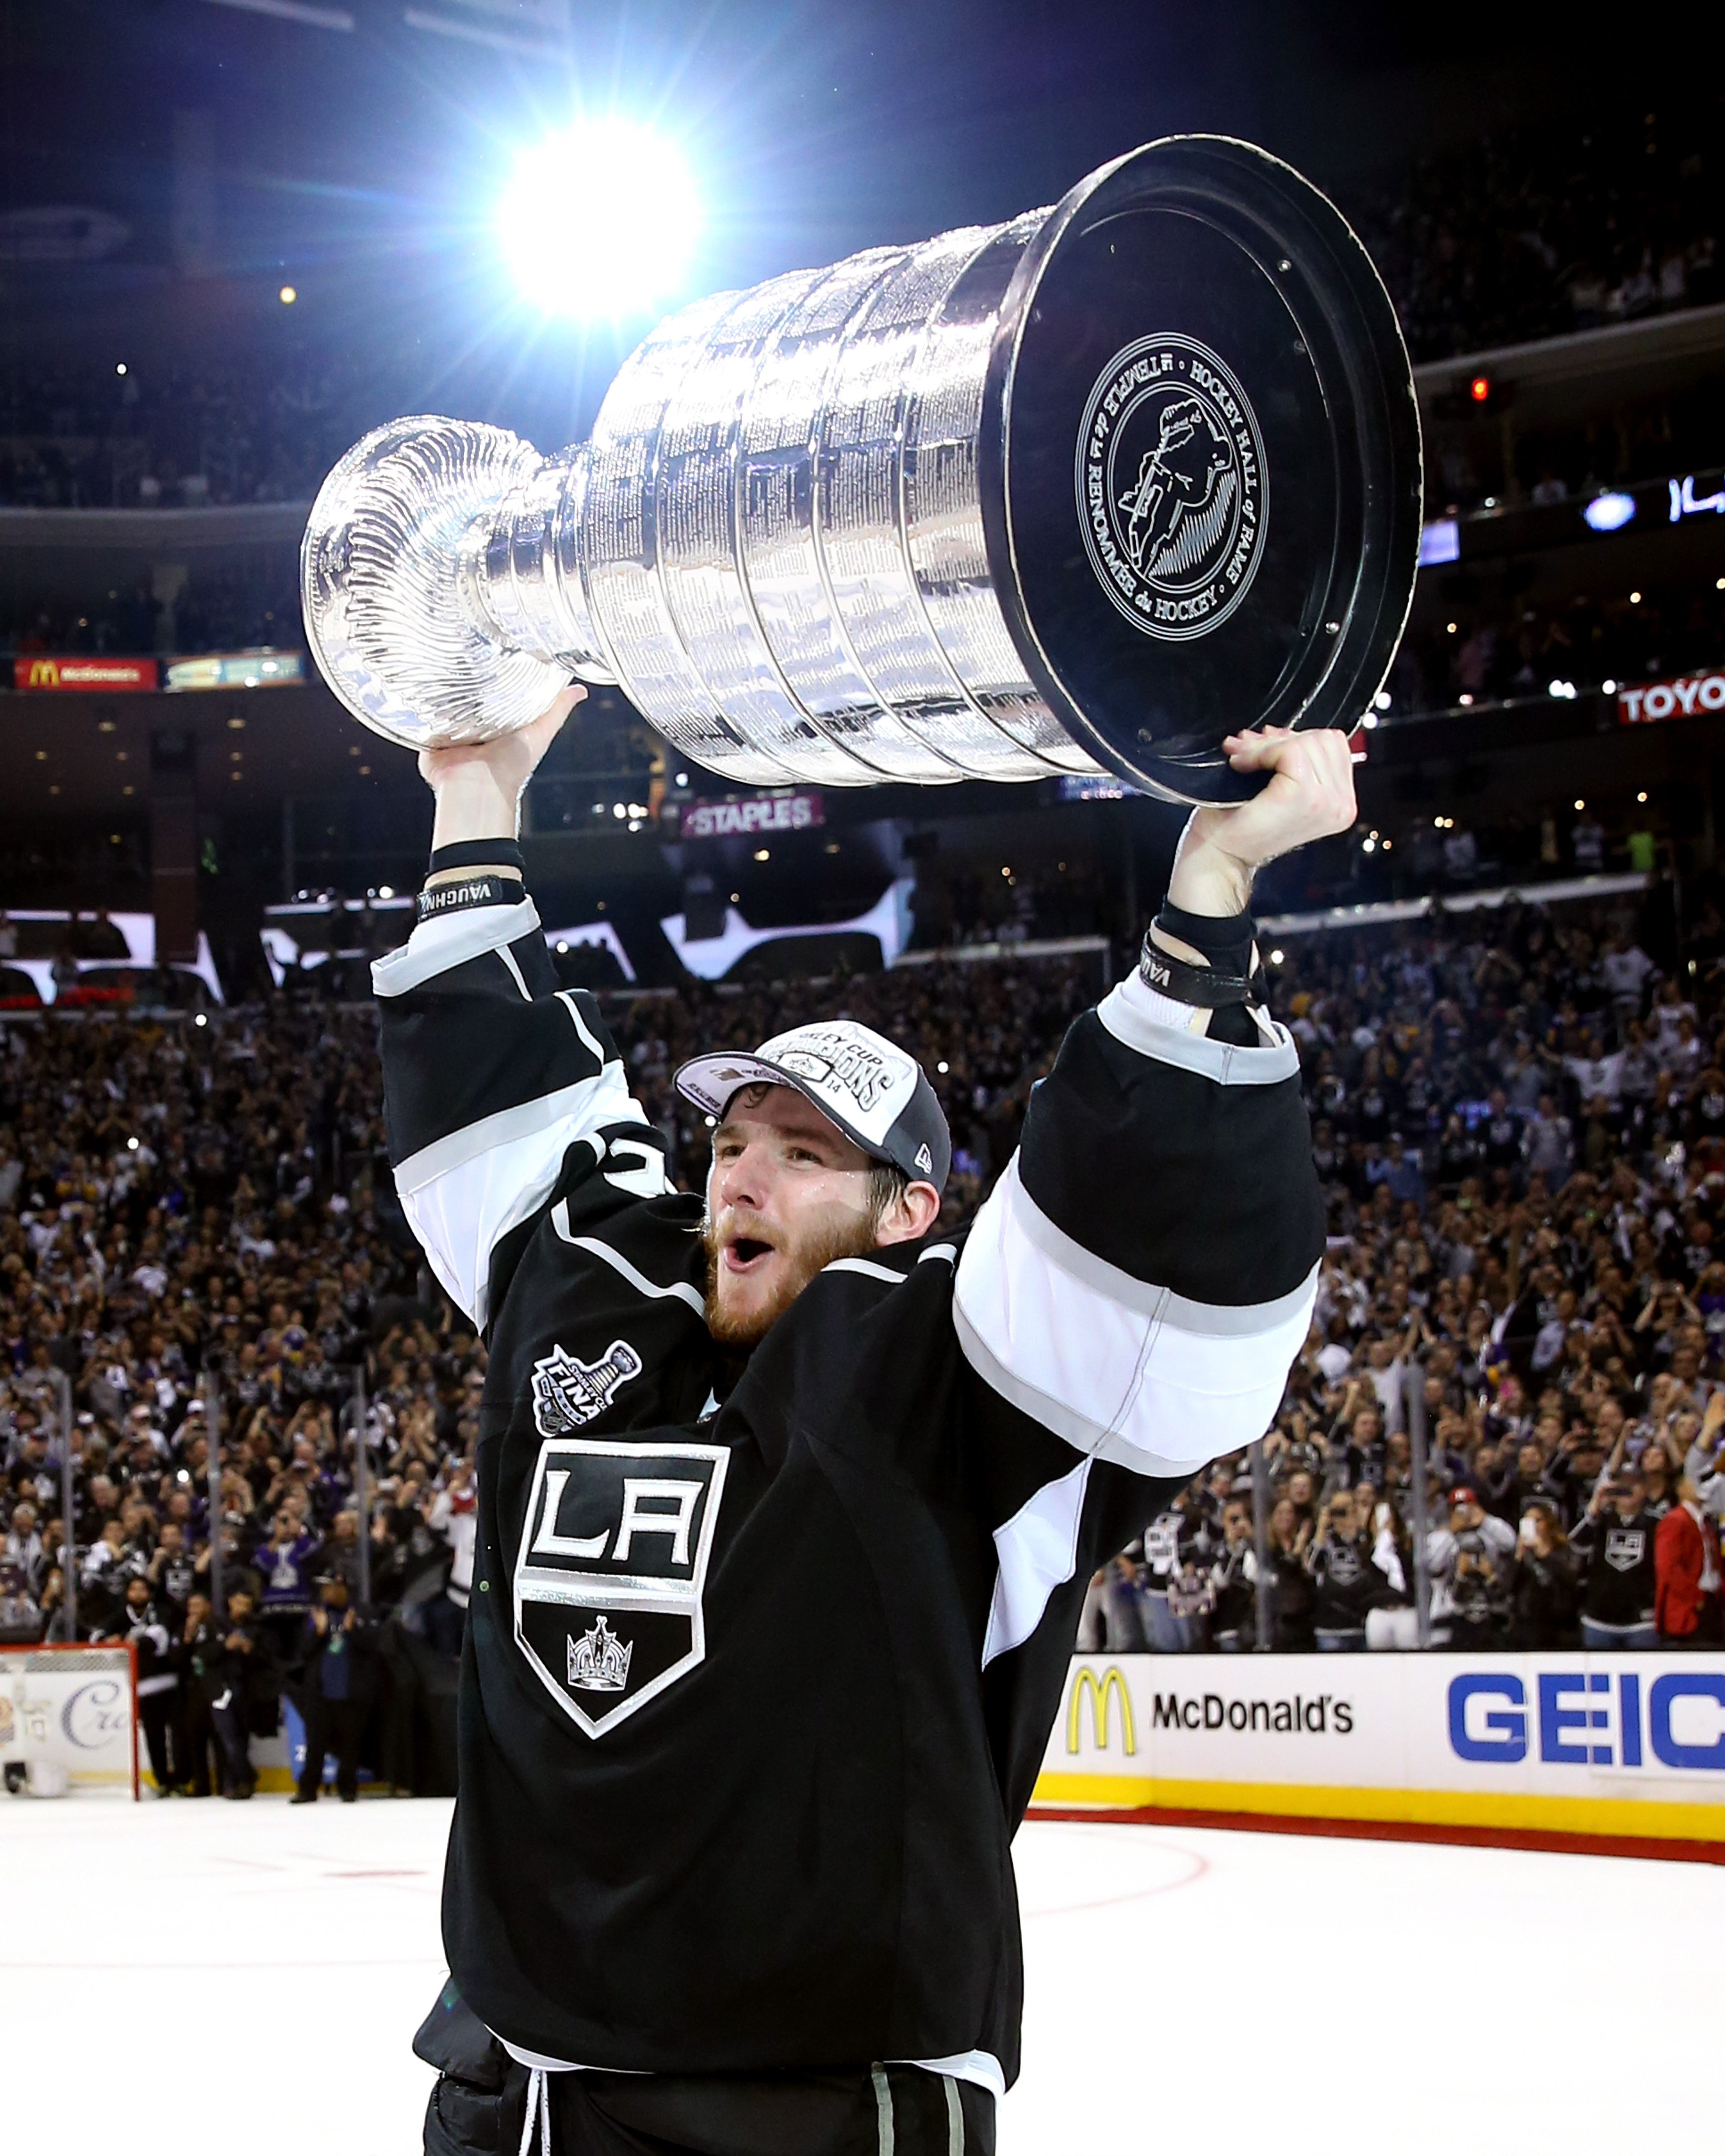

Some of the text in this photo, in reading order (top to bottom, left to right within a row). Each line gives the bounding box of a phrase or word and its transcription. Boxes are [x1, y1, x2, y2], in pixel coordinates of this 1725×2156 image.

[1103, 356, 1161, 416] TEMPLE
[1095, 412, 1109, 438] de
[1190, 360, 1257, 585] HOCKEY HALL of FAME
[1088, 463, 1137, 598] RENOMMÉE
[1135, 590, 1153, 613] du
[1154, 585, 1217, 621] HOCKEY
[1619, 676, 1725, 722] TOYO
[693, 796, 812, 835] STAPLES
[425, 884, 492, 912] VAUGHN
[846, 1044, 883, 1066] CUP
[826, 1079, 842, 1094] 14
[568, 1364, 599, 1398] STANLEY
[531, 1470, 704, 1565] LA
[1153, 1694, 1354, 1733] McDonald's
[1449, 1674, 1725, 1770] GEIC
